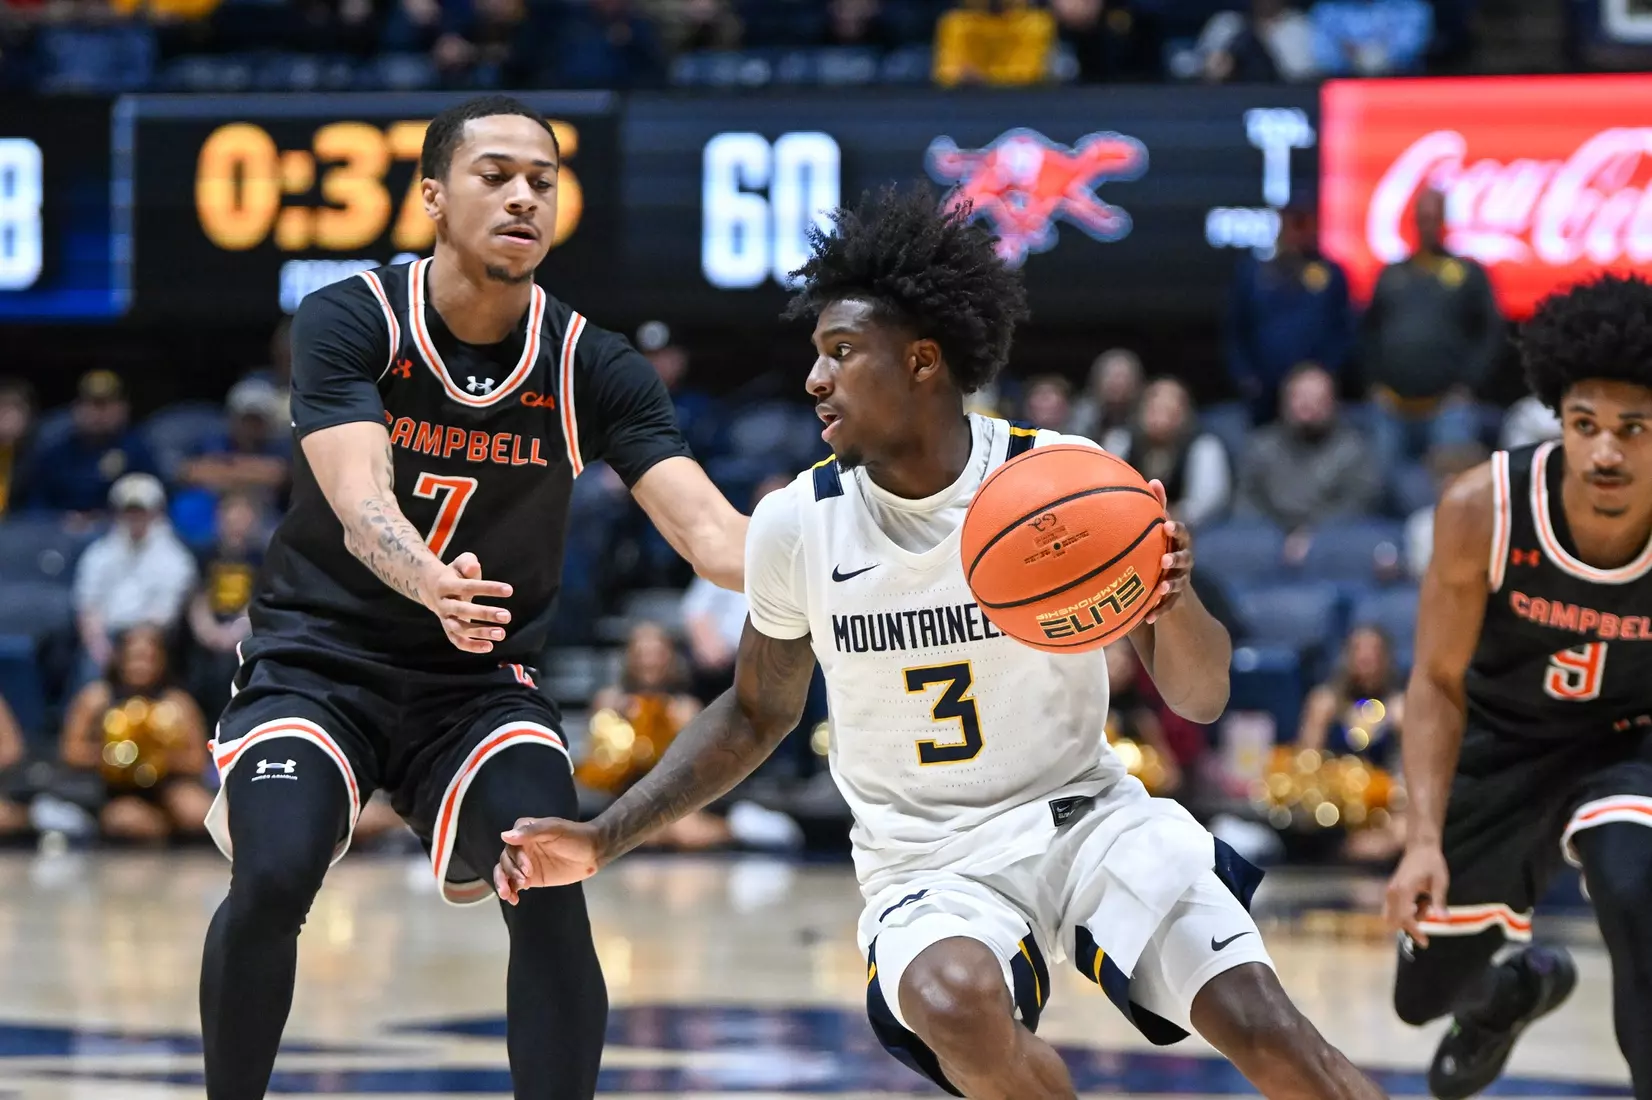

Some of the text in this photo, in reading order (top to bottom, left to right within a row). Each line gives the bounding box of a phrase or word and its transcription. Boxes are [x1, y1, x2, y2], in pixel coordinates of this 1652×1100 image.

[703, 131, 841, 289] 60
[520, 391, 556, 410] CAA
[384, 410, 548, 467] AMPBELL
[412, 471, 479, 561] 7
[1035, 565, 1135, 621] CHAMPIONSHIP
[1038, 571, 1147, 640] ELITE
[831, 602, 1007, 653] MOUNTAINEE
[902, 659, 986, 767] 3
